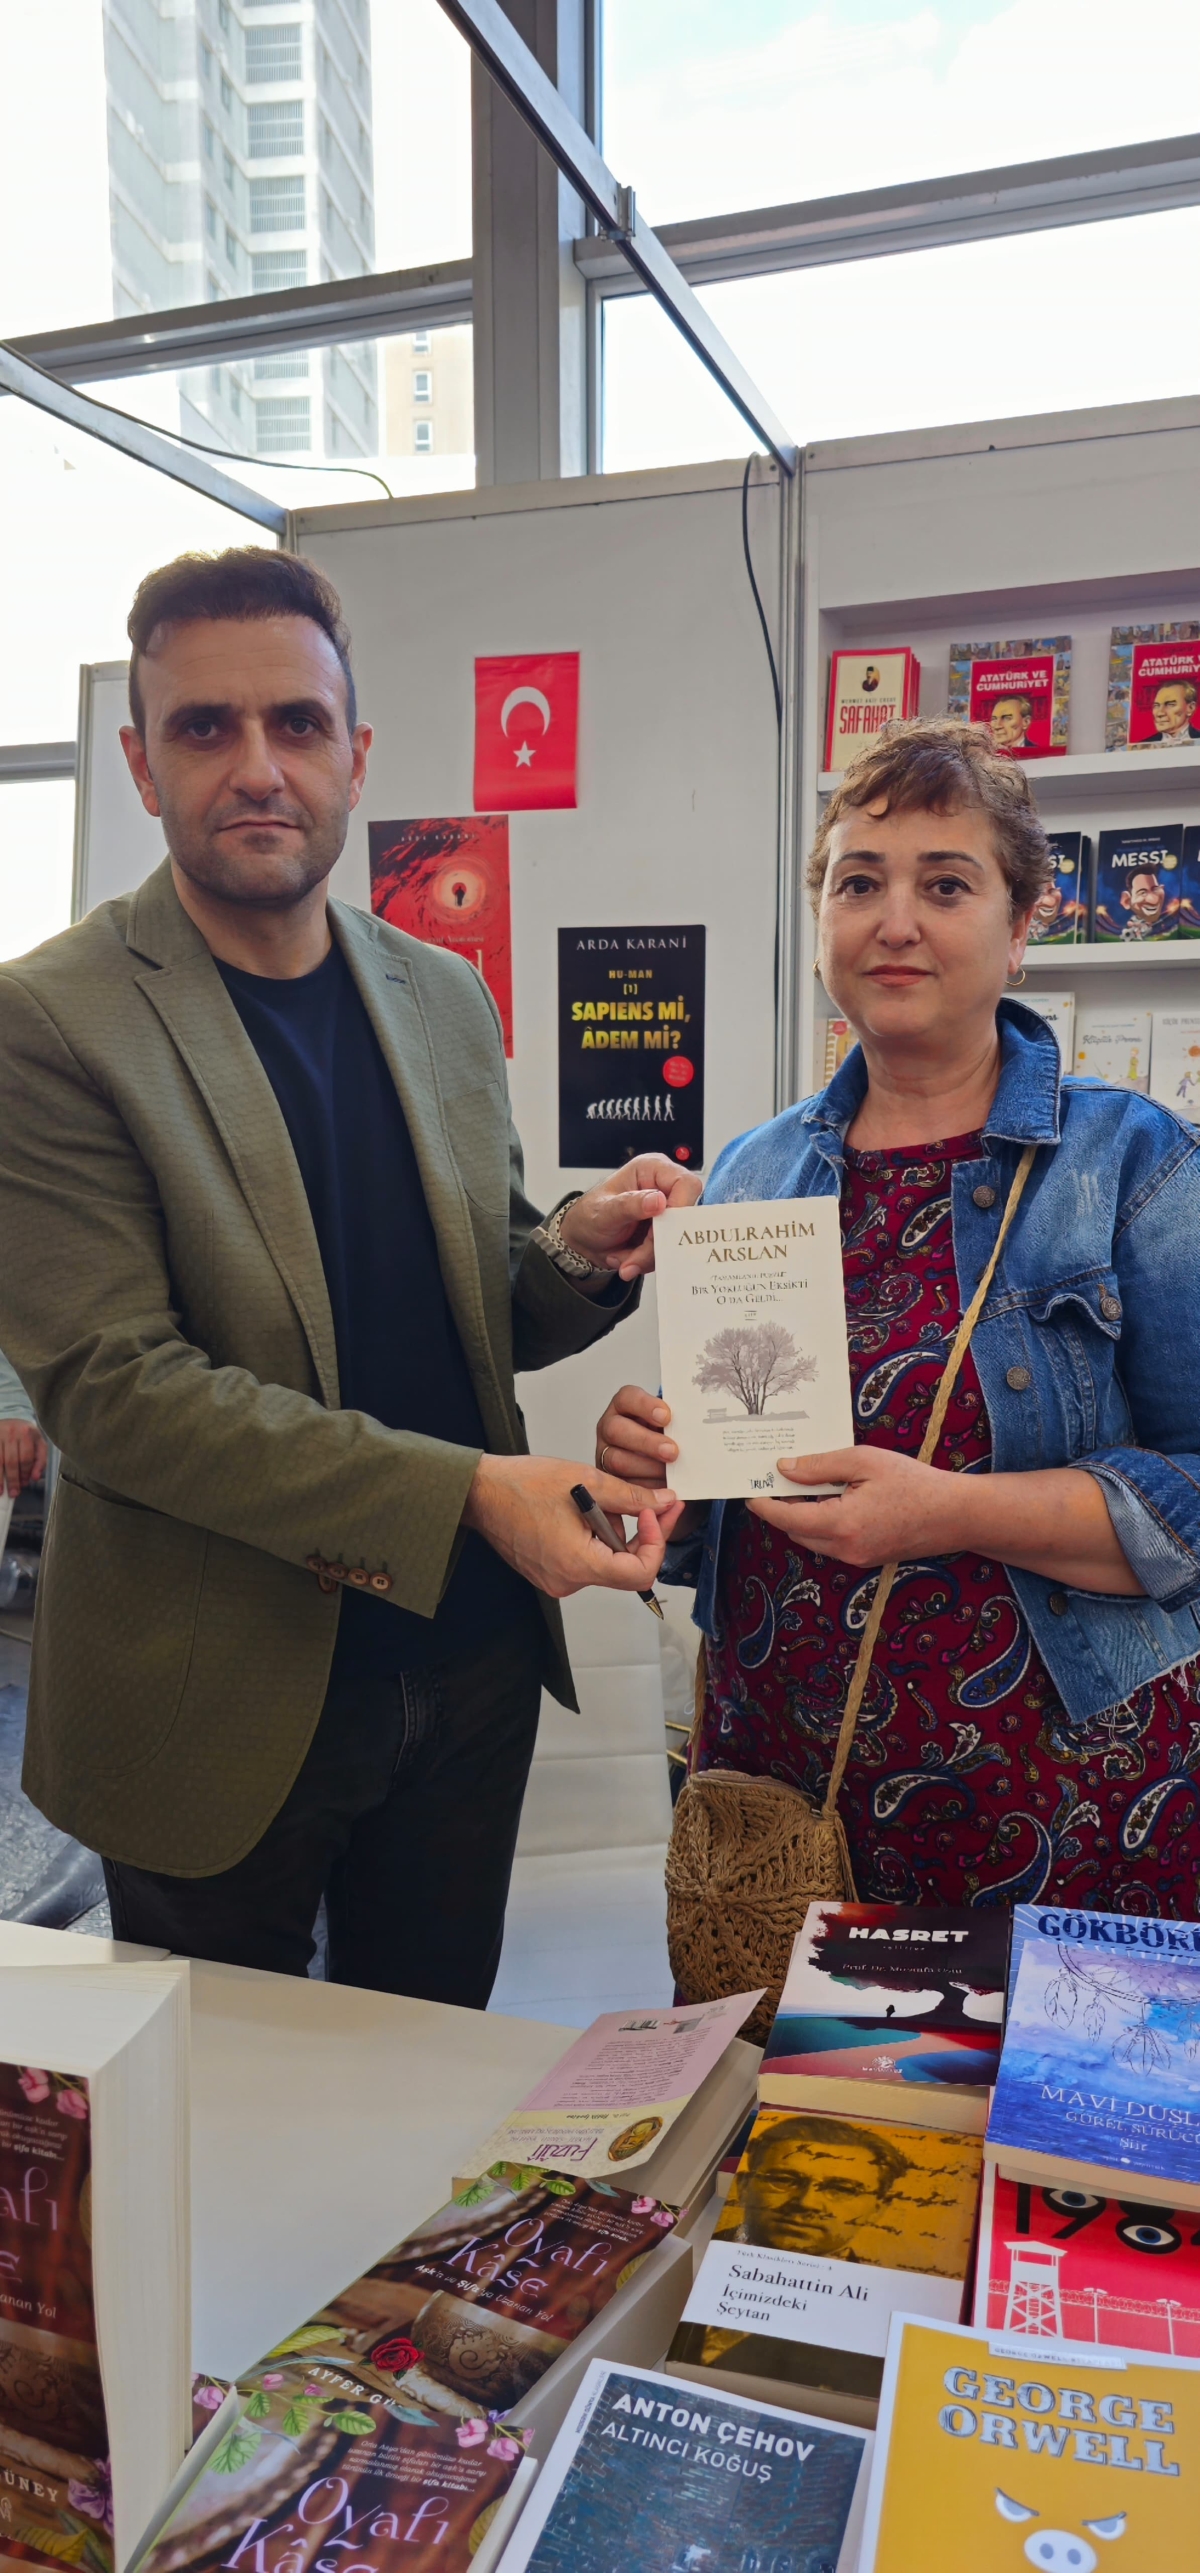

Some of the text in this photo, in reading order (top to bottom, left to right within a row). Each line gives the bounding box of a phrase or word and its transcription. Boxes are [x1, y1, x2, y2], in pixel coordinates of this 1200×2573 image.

[1142, 655, 1194, 668] ATATÜRK
[976, 679, 1049, 692] CUMHURİYET
[979, 669, 1047, 683] ATATÜRK VE
[1111, 849, 1168, 869] MESSI
[576, 935, 687, 951] ARDA KARANİ
[608, 969, 653, 979] HU-MAN
[623, 983, 638, 995] [1]
[571, 995, 691, 1023] SAPIENS Mİ,
[581, 1024, 682, 1050] ÂDEM Mİ?
[678, 1220, 816, 1246] ABDULRAHİM
[706, 1244, 788, 1264] ARSLAN
[716, 1295, 727, 1305] O
[848, 1926, 970, 1943] HASRET
[1041, 2085, 1117, 2113] MAVİ
[443, 2236, 550, 2299] Kâse
[728, 2264, 870, 2302] Sabahattin Ali
[37, 2302, 57, 2319] Yol
[495, 2294, 534, 2316] Uzanan
[533, 2308, 554, 2323] Yol
[722, 2283, 808, 2312] İçimizdeki
[716, 2301, 771, 2321] Şeytan
[307, 2367, 365, 2396] AYFER
[943, 2365, 1175, 2434] GEORGE
[611, 2393, 815, 2462] ANTON ÇEHOV
[938, 2404, 1180, 2477] ORWELL
[360, 2440, 482, 2467] Orta Asya'dan günümüze kadar
[600, 2422, 773, 2484] ALTINCI KOĞUŞ
[410, 2475, 422, 2483] bir
[422, 2478, 440, 2487] şifa
